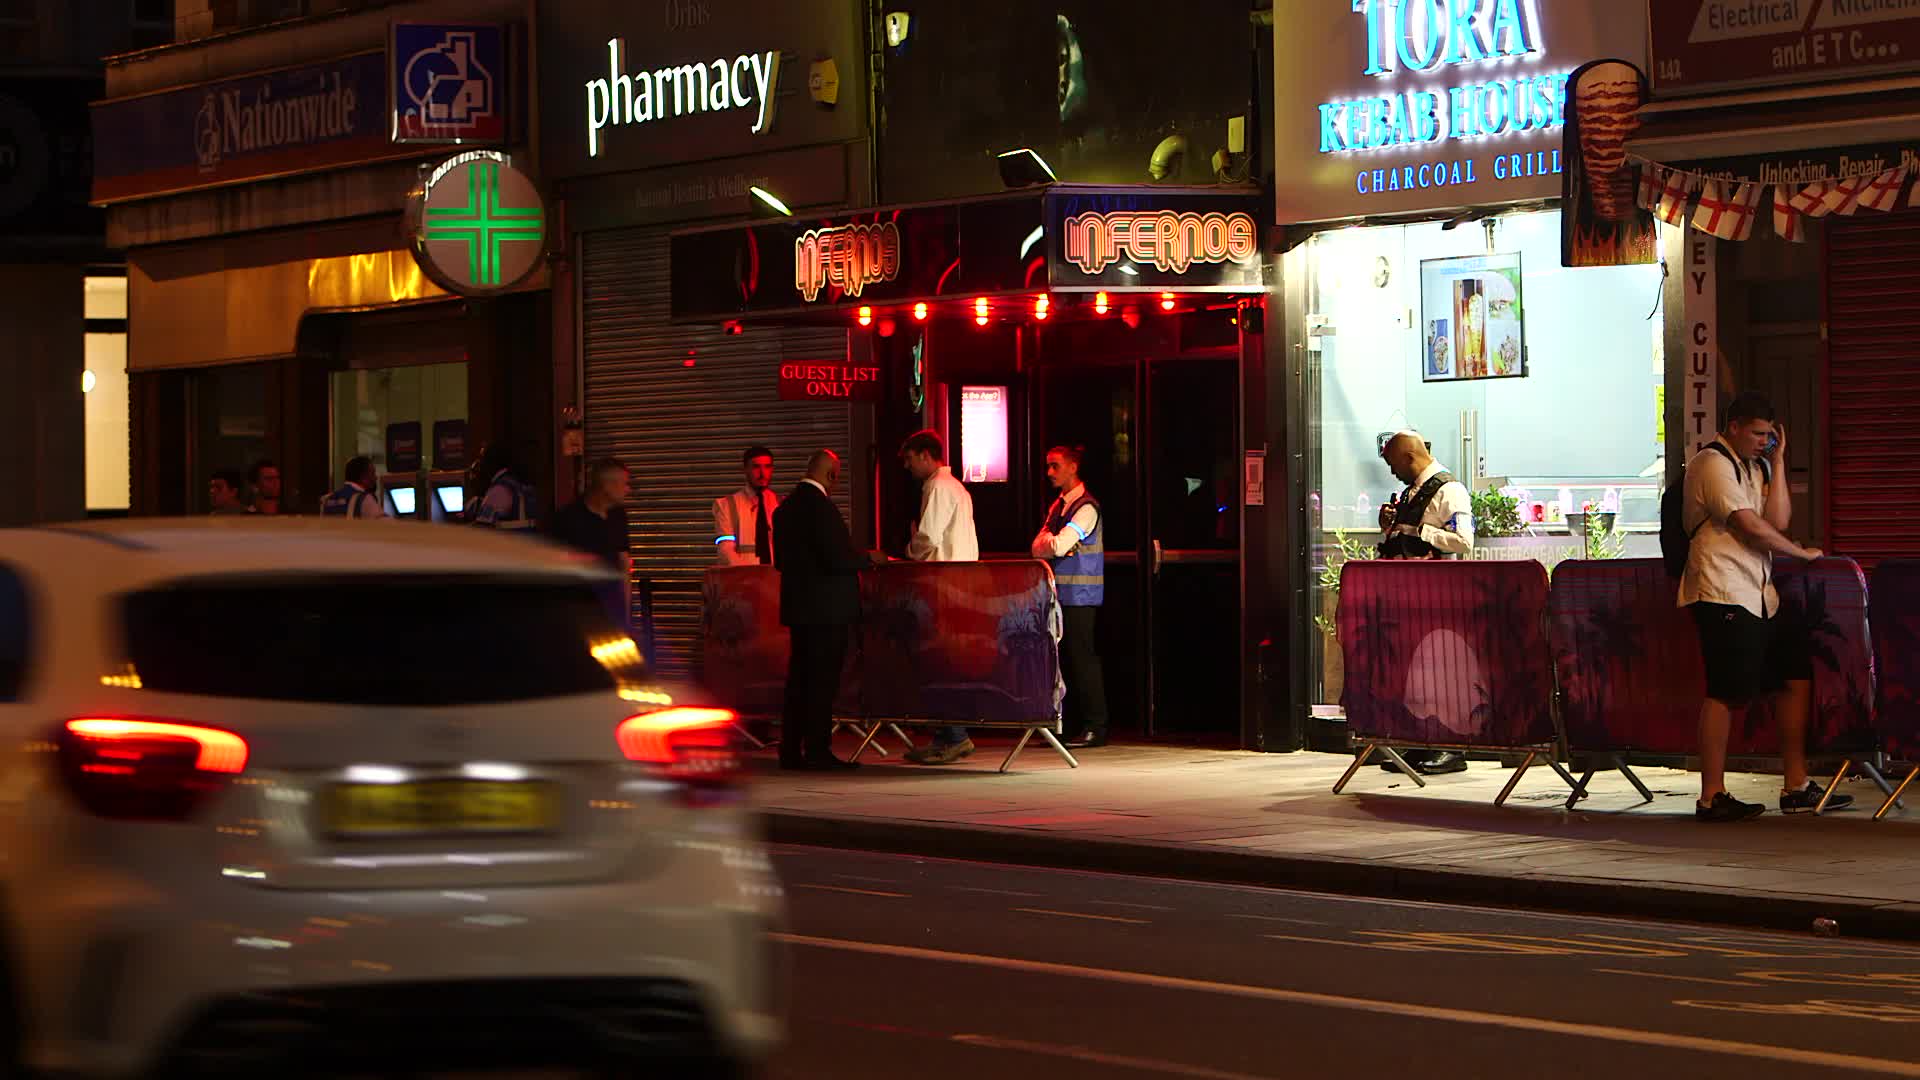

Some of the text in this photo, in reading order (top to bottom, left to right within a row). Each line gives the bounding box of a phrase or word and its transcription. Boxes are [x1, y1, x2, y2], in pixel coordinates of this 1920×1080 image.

[1353, 0, 1536, 75] TORA
[1708, 0, 1799, 30] Electrical
[1772, 36, 1807, 69] and
[222, 72, 356, 152] Nationwide
[585, 37, 778, 158] pharmacy
[1318, 74, 1570, 152] KEBAB HOUSE
[1357, 150, 1563, 194] CHARCOAL GRILL
[1760, 160, 1827, 185] Unlocking
[1840, 153, 1885, 179] Repair
[796, 222, 900, 301] INFERNOS
[1065, 210, 1256, 274] INFERNOS
[1692, 228, 1706, 295] EY
[782, 365, 880, 381] GUEST LIST
[807, 381, 853, 397] ONLY
